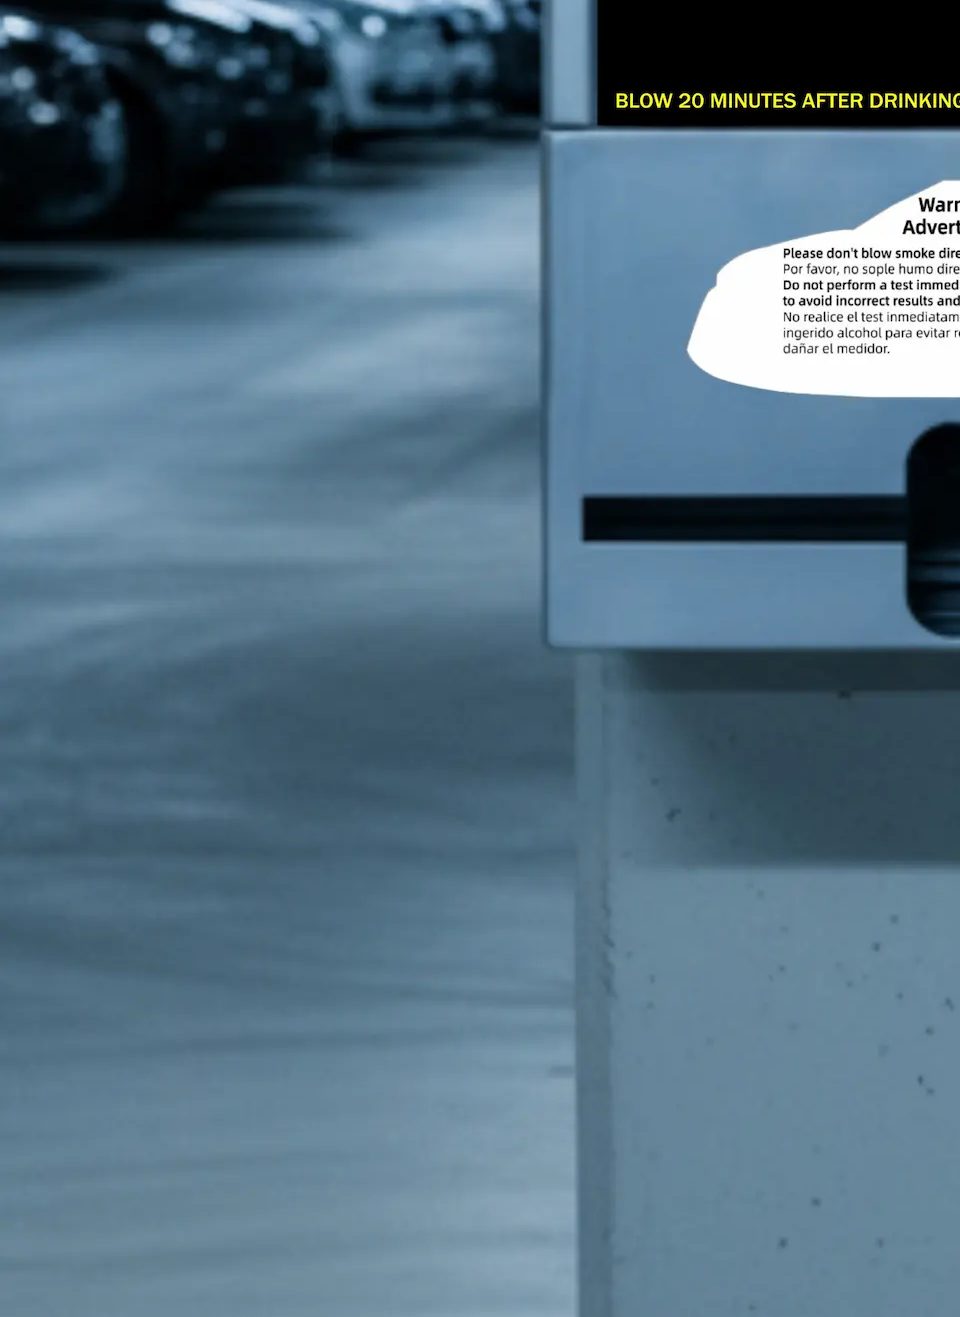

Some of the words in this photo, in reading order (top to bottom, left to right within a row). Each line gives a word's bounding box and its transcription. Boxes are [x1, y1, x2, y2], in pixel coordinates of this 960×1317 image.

[615, 92, 674, 109] BLOW
[678, 92, 705, 109] 20
[710, 92, 797, 109] MINUTES
[801, 92, 864, 109] AFTER
[783, 247, 824, 259] Please
[826, 247, 859, 259] don't
[861, 247, 892, 259] blow
[895, 247, 936, 259] smoke
[783, 263, 804, 275] Por
[806, 262, 840, 276] favor,
[843, 265, 859, 275] no
[862, 263, 895, 277] sople
[898, 263, 934, 275] humo
[783, 279, 800, 291] Do
[803, 280, 824, 291] not
[826, 279, 876, 293] perform
[879, 281, 887, 291] a
[890, 280, 914, 291] test
[782, 295, 796, 307] to
[798, 294, 833, 307] avoid
[836, 294, 890, 307] incorrect
[893, 294, 934, 307] results
[936, 294, 960, 307] and
[783, 311, 800, 323] No
[803, 311, 844, 323] realice
[846, 311, 858, 323] el
[861, 312, 884, 323] test
[783, 327, 834, 340] ingerido
[836, 327, 882, 339] alcohol
[885, 329, 913, 340] para
[916, 327, 950, 339] evitar
[782, 342, 820, 355] dañar
[822, 343, 834, 354] el
[837, 342, 890, 354] medidor.
